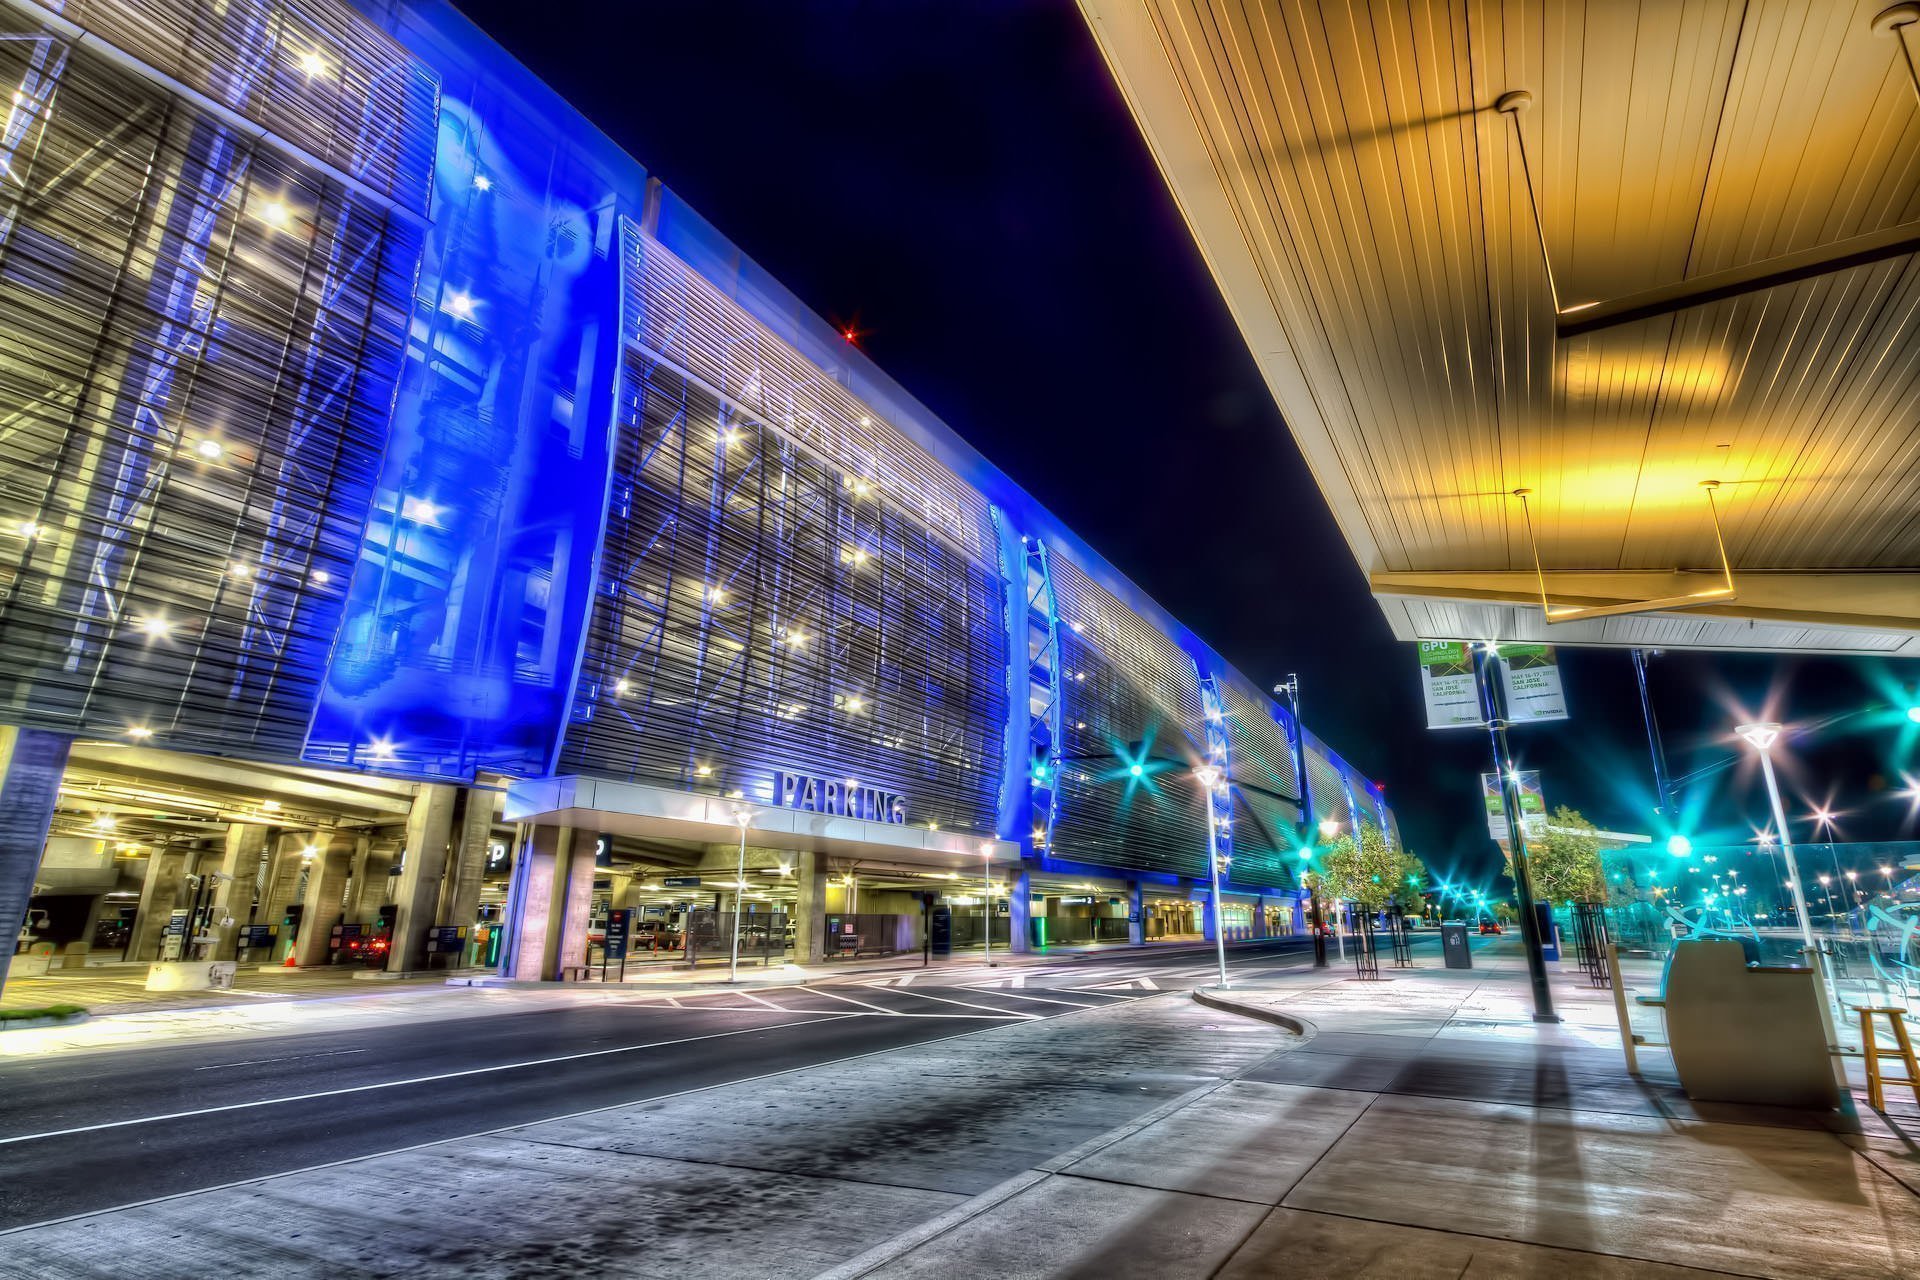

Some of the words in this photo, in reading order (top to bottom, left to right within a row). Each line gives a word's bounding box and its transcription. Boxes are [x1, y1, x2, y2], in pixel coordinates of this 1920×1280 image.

[1422, 641, 1448, 652] GPU
[1512, 682, 1549, 691] CALIFORNIA
[778, 771, 906, 825] PARKING
